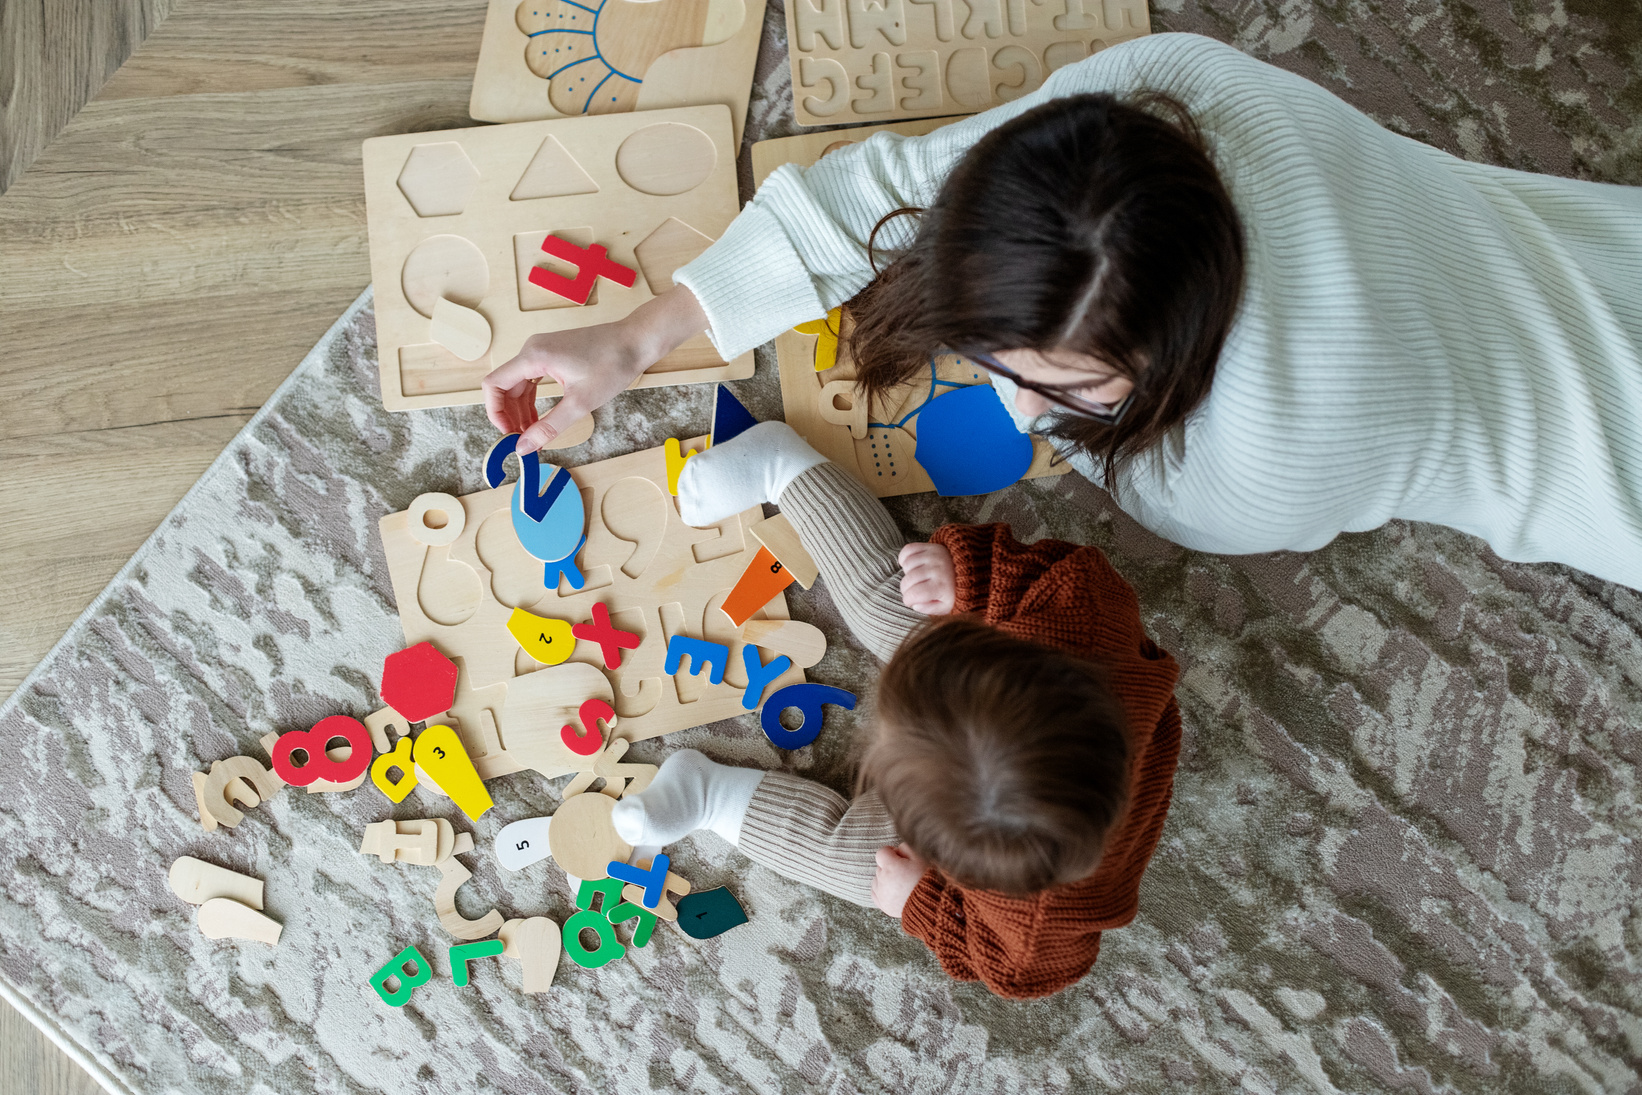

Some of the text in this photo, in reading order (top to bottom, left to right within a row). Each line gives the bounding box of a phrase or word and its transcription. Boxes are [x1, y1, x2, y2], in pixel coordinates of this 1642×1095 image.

[528, 235, 637, 306] 4
[482, 432, 571, 523] 2
[538, 632, 553, 645] 2
[571, 602, 640, 670] X
[664, 635, 729, 685] E
[741, 644, 791, 710] Y
[560, 699, 618, 755] S
[761, 683, 857, 750] 6
[271, 715, 374, 788] 8
[432, 746, 446, 760] 3
[516, 839, 530, 852] 5
[606, 853, 670, 909] T
[449, 939, 504, 987] L
[562, 910, 626, 969] Q
[369, 945, 433, 1007] B
